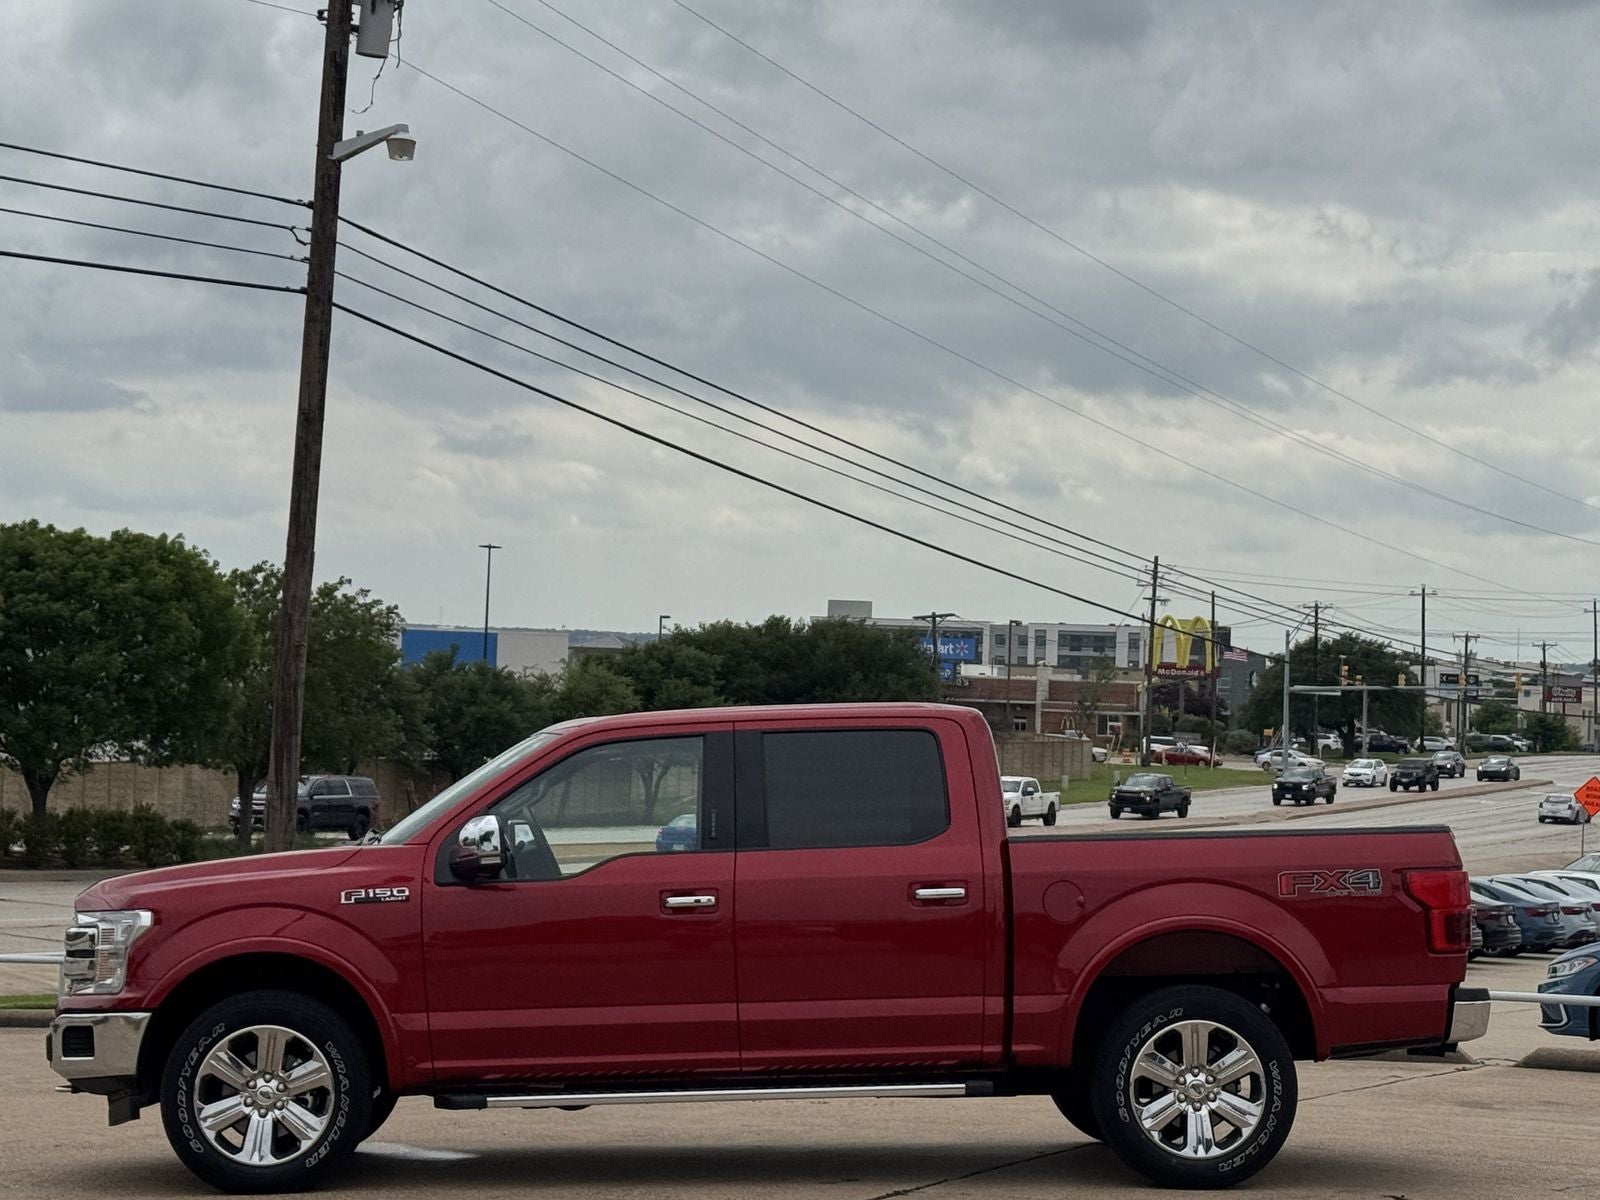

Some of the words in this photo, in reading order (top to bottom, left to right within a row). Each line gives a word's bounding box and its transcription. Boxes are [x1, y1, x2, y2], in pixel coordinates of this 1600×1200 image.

[1157, 668, 1205, 677] McDonald's
[1278, 868, 1382, 897] FX4
[176, 1022, 226, 1154] GOODYEAR
[305, 1041, 350, 1168] WRANGLER
[1115, 1007, 1184, 1123] GOODYEAR
[1217, 1060, 1283, 1173] WRANGLER
